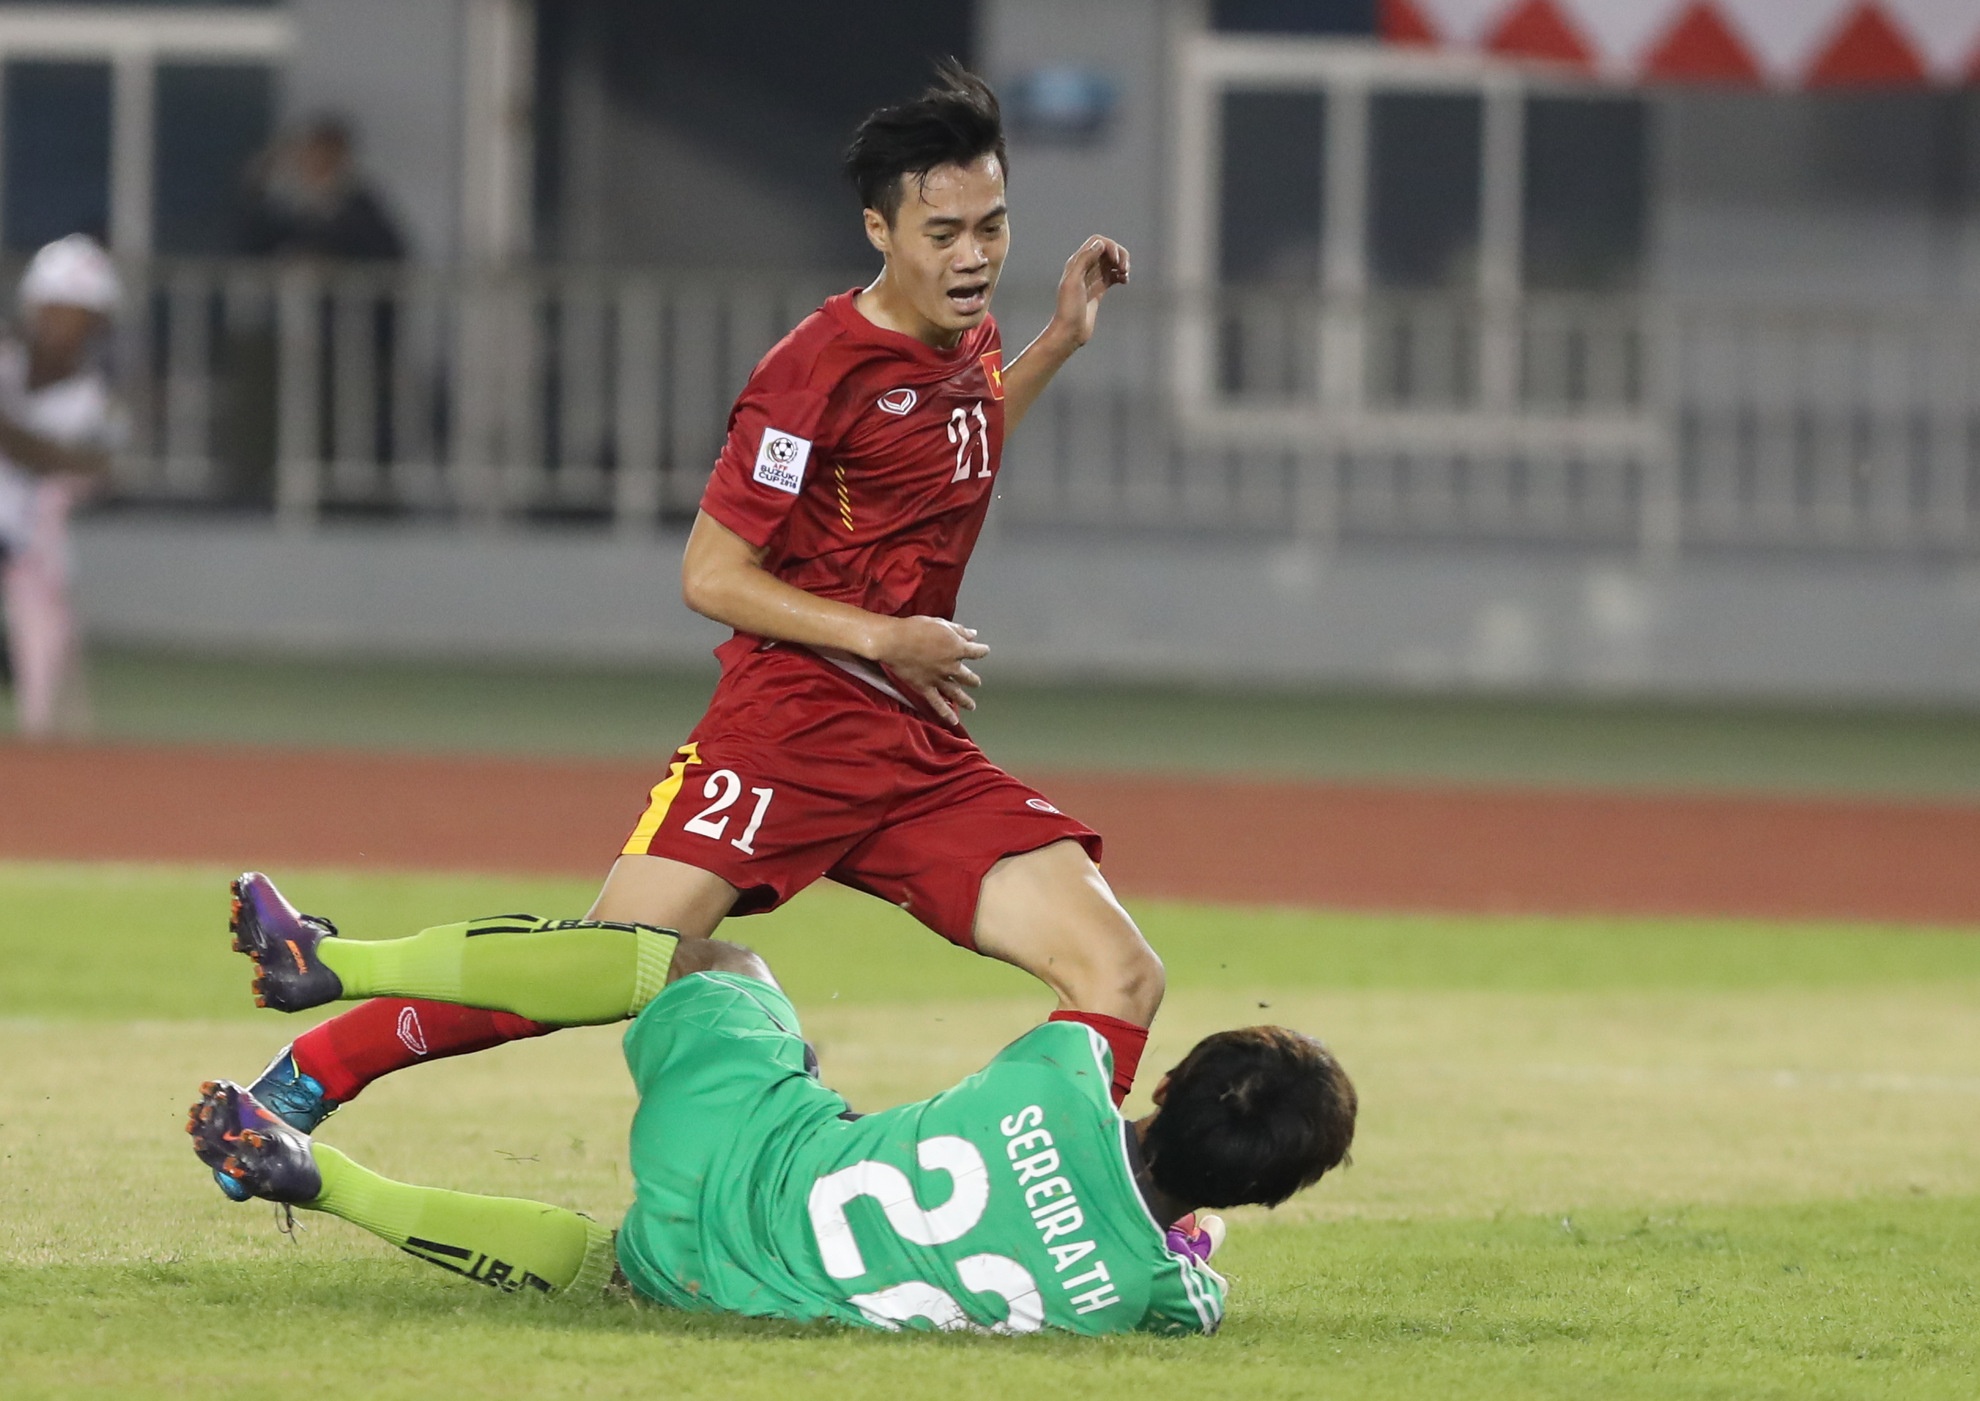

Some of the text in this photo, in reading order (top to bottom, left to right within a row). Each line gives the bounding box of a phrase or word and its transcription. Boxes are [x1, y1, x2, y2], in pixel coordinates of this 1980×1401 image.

[758, 472, 780, 482] CUP
[760, 465, 799, 482] SUZUKI
[773, 463, 788, 471] AFF
[947, 401, 992, 483] 21
[683, 769, 774, 856] 21
[808, 1135, 1046, 1333] 22
[1000, 1105, 1122, 1315] SEREIRATH
